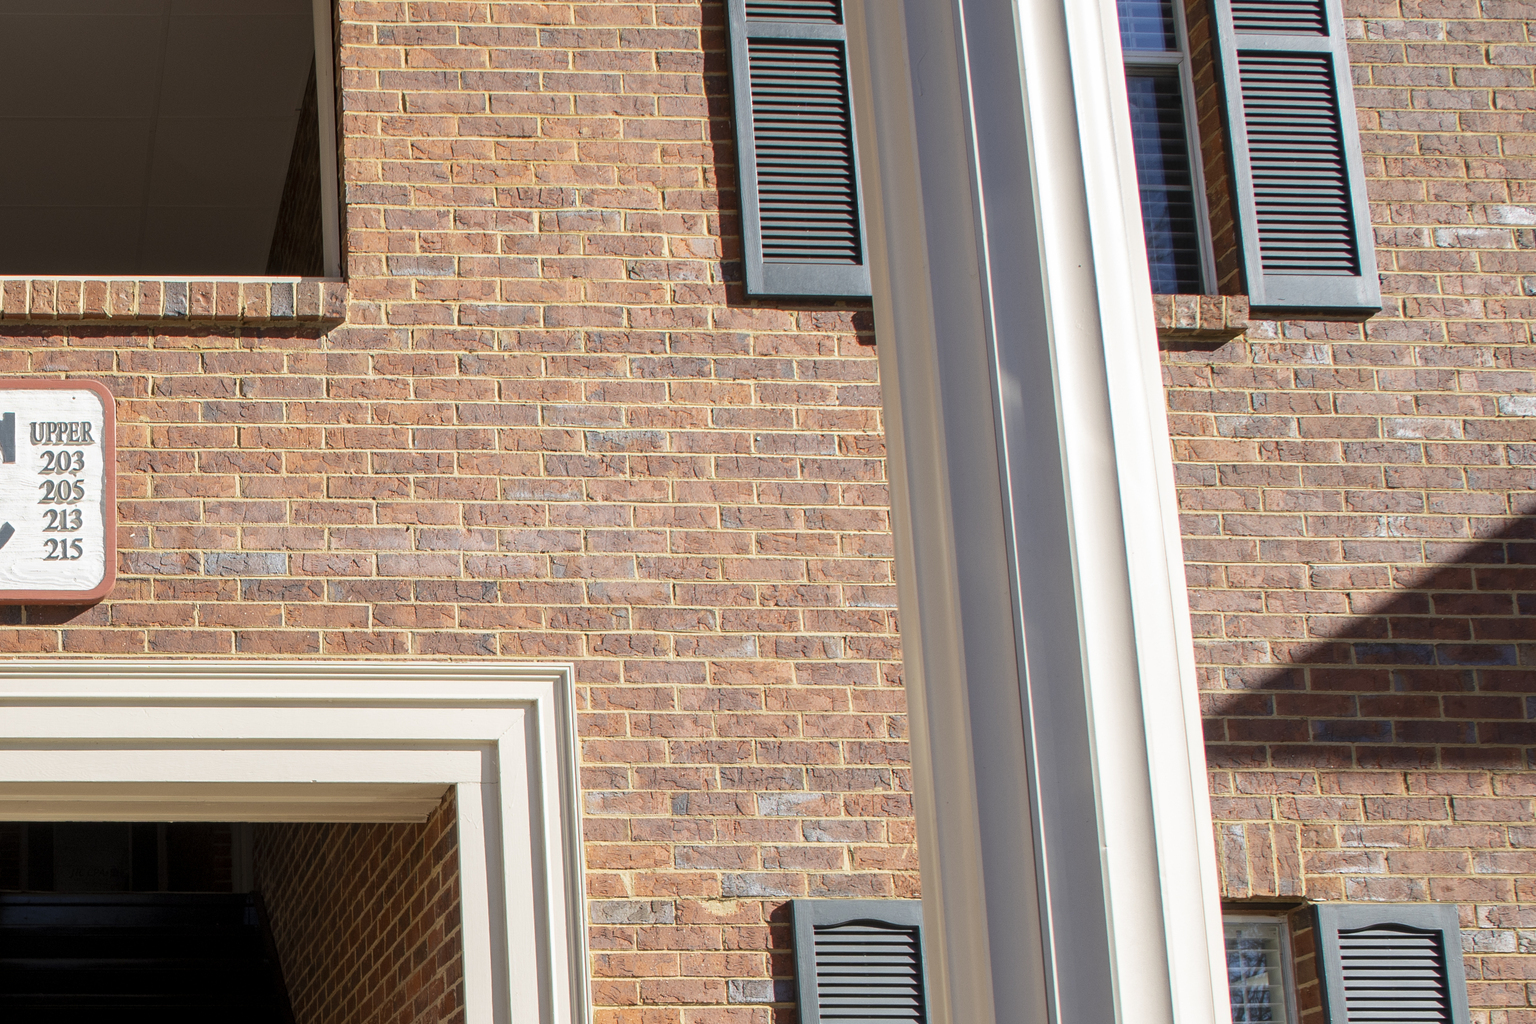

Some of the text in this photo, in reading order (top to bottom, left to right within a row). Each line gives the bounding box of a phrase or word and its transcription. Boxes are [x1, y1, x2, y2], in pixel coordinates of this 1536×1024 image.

[29, 421, 96, 446] UPPER
[37, 450, 86, 476] 203
[37, 478, 86, 504] 205
[42, 508, 84, 533] 213
[42, 537, 85, 562] 215
